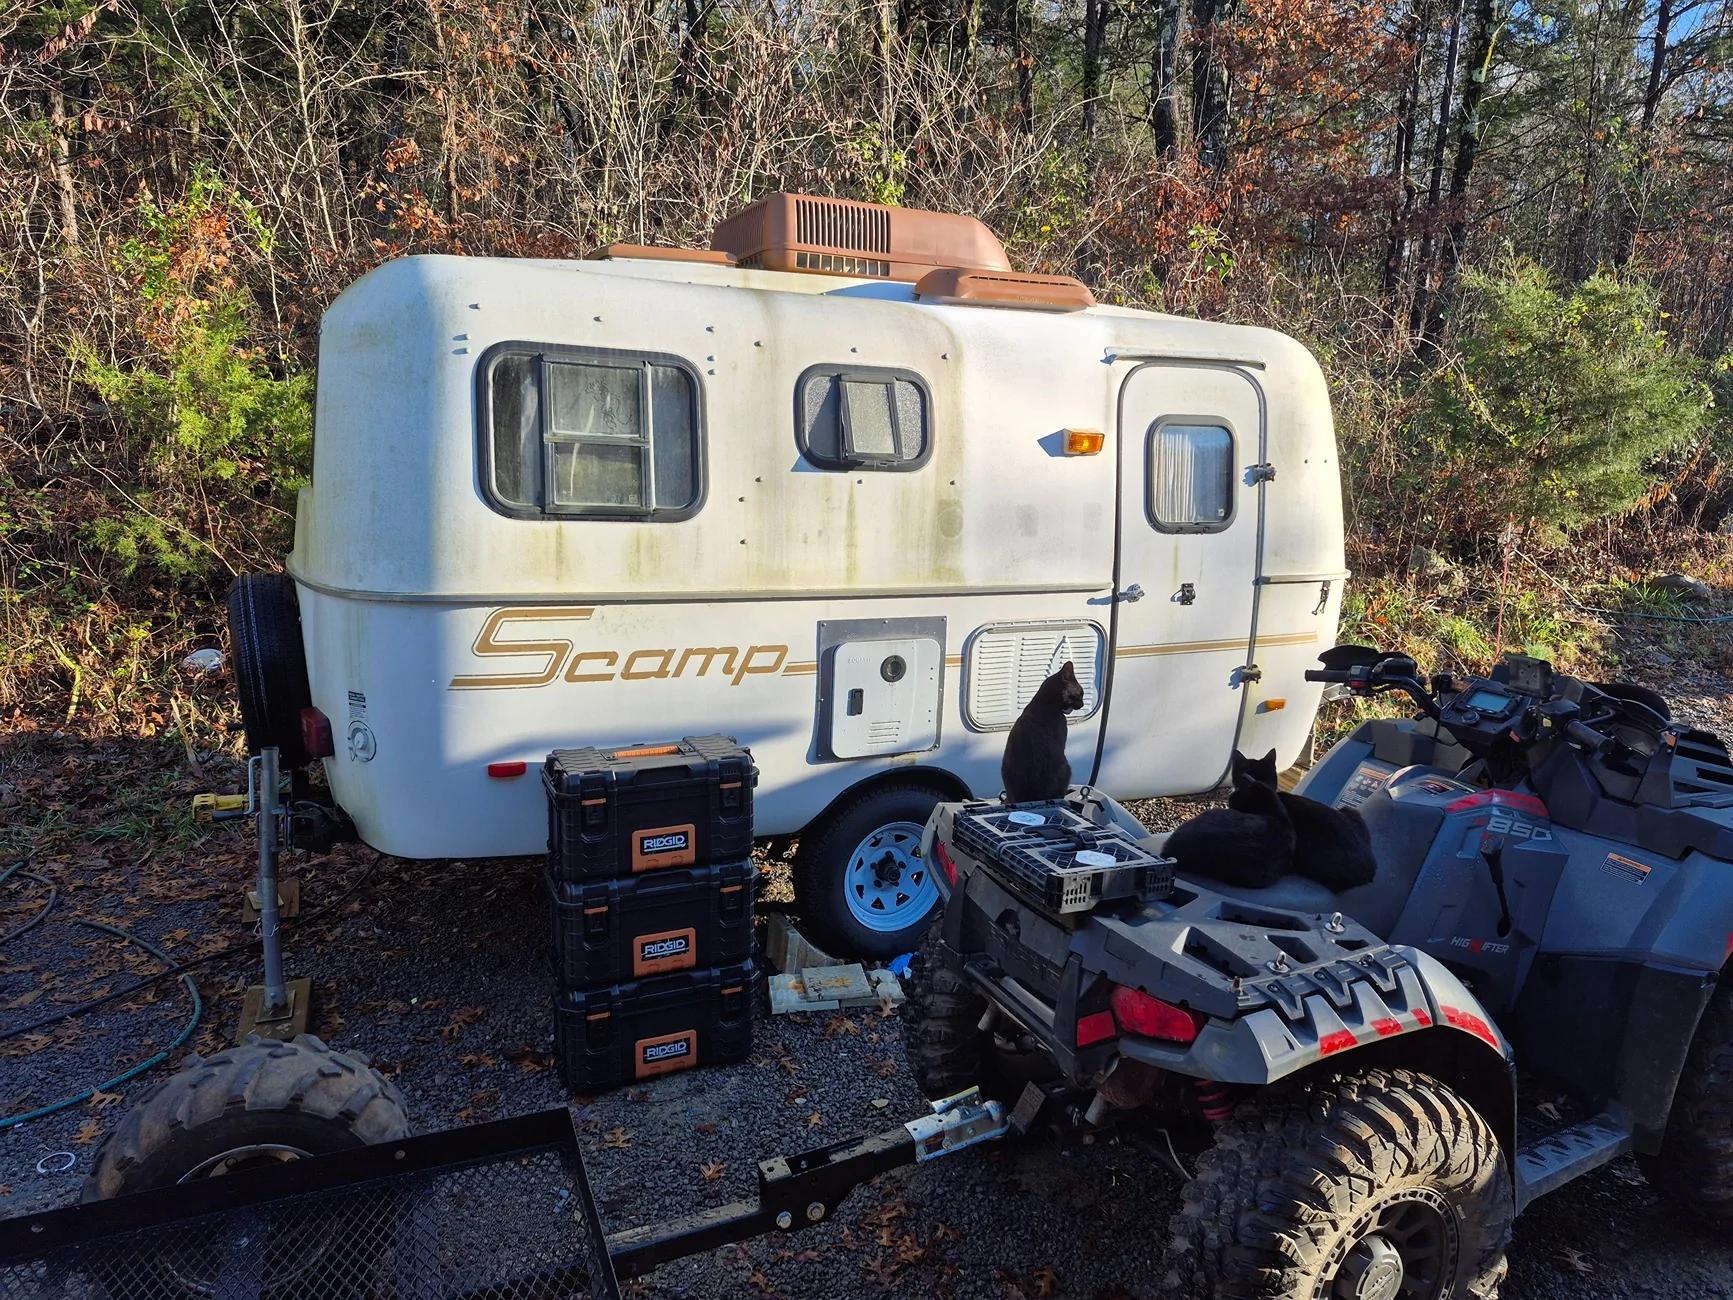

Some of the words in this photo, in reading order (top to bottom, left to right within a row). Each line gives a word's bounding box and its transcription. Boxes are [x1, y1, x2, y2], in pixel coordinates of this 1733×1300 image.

[447, 605, 789, 690] Scamp
[1486, 817, 1553, 841] 850
[644, 835, 686, 849] RIDGID
[645, 939, 686, 954] RIDGID
[646, 1042, 687, 1058] RIDGID
